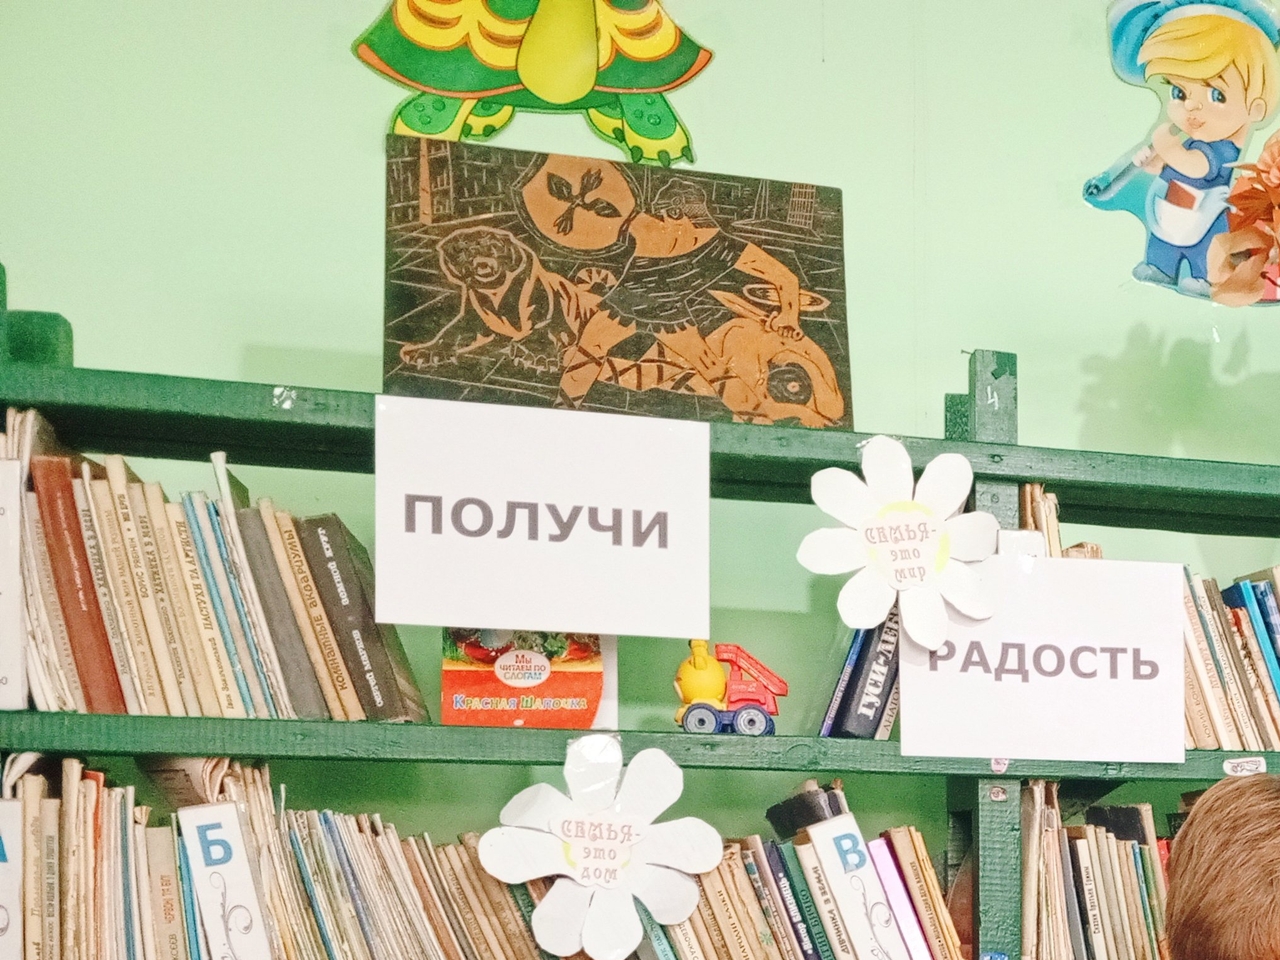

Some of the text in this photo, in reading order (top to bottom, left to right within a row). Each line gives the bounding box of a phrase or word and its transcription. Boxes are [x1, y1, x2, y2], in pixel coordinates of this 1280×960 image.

[137, 514, 151, 539] МОРІ
[404, 494, 668, 548] ПОЛУЧИ
[175, 518, 195, 566] АРТИСТИ
[135, 570, 149, 598] БОРИС
[145, 549, 164, 595] ХАТИНКА
[187, 568, 199, 581] ТА
[895, 567, 926, 582] мир
[191, 582, 213, 631] ПАСТУХИ
[1182, 594, 1219, 690] АТАКУЮТ ТАНКИСТЫ
[499, 664, 546, 672] ЧИТАЕМ ПО
[503, 671, 543, 681] СЛОГАМ
[928, 639, 1161, 682] РАДОСТЬ
[453, 694, 588, 711] КРАСНАЯ ШАПОЧКА
[1195, 709, 1211, 739] ЮРИЙ
[194, 821, 235, 869] Б
[583, 846, 617, 860] это
[832, 831, 868, 875] В
[581, 867, 618, 881] дом
[811, 865, 828, 896] ЗЕМЛІ
[716, 889, 733, 919] КАЗКИ
[778, 876, 802, 922] БЛИЗНЕЦЬ
[798, 888, 819, 928] БИЧКО
[677, 923, 697, 956] ДЕВОЧКА
[794, 921, 813, 950] Віктор
[826, 907, 850, 956] ДІВЧИНКА
